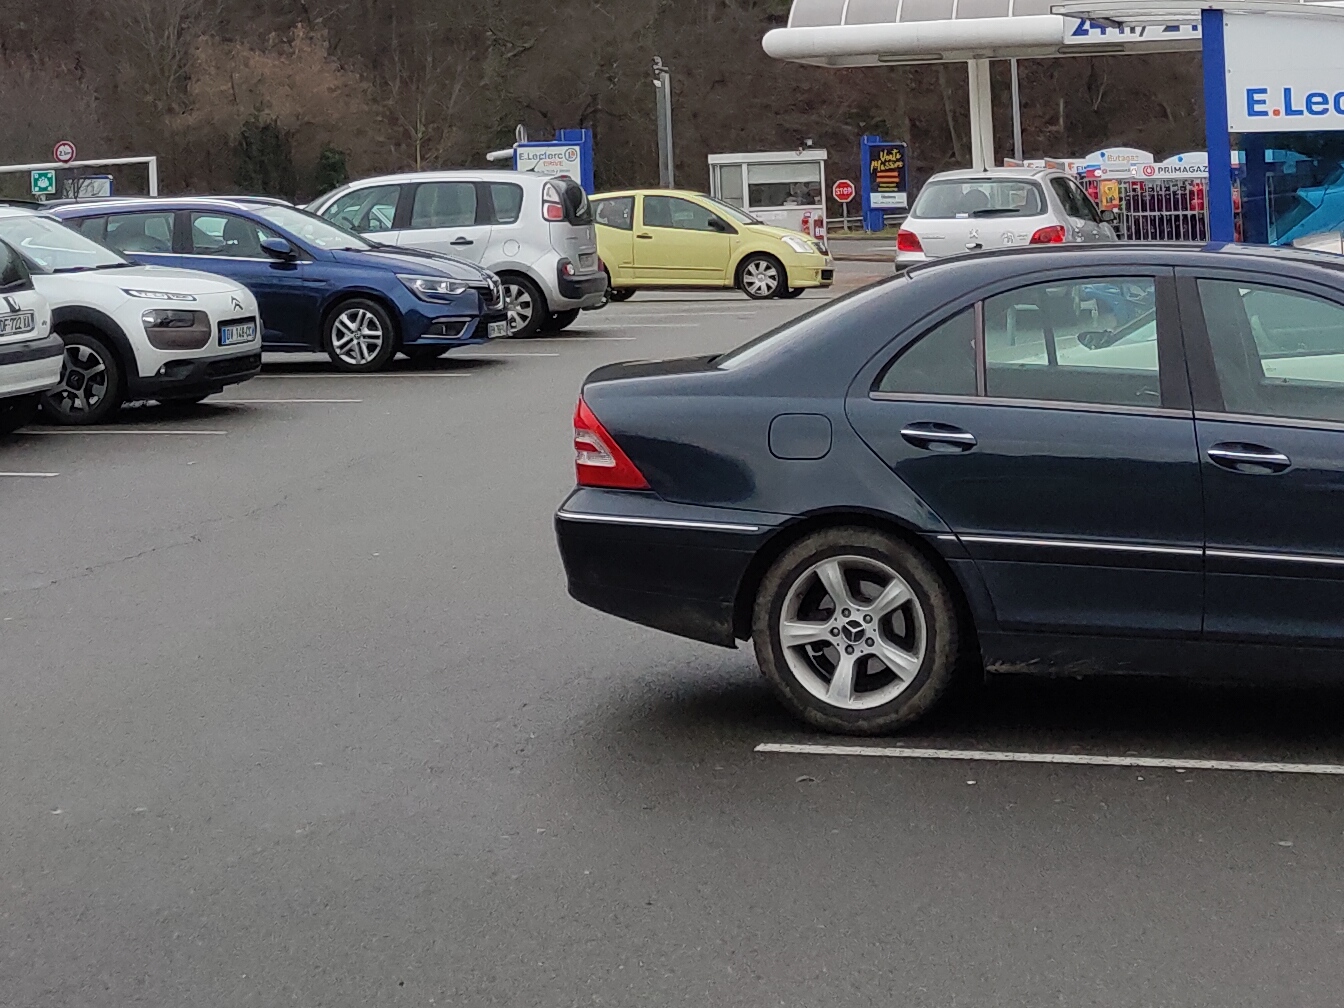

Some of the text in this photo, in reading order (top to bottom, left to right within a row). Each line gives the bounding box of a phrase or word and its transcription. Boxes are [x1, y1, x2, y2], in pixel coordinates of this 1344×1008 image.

[1107, 154, 1139, 163] Butagaz
[1157, 165, 1209, 174] PRIMAGAZ
[835, 186, 853, 195] STOP
